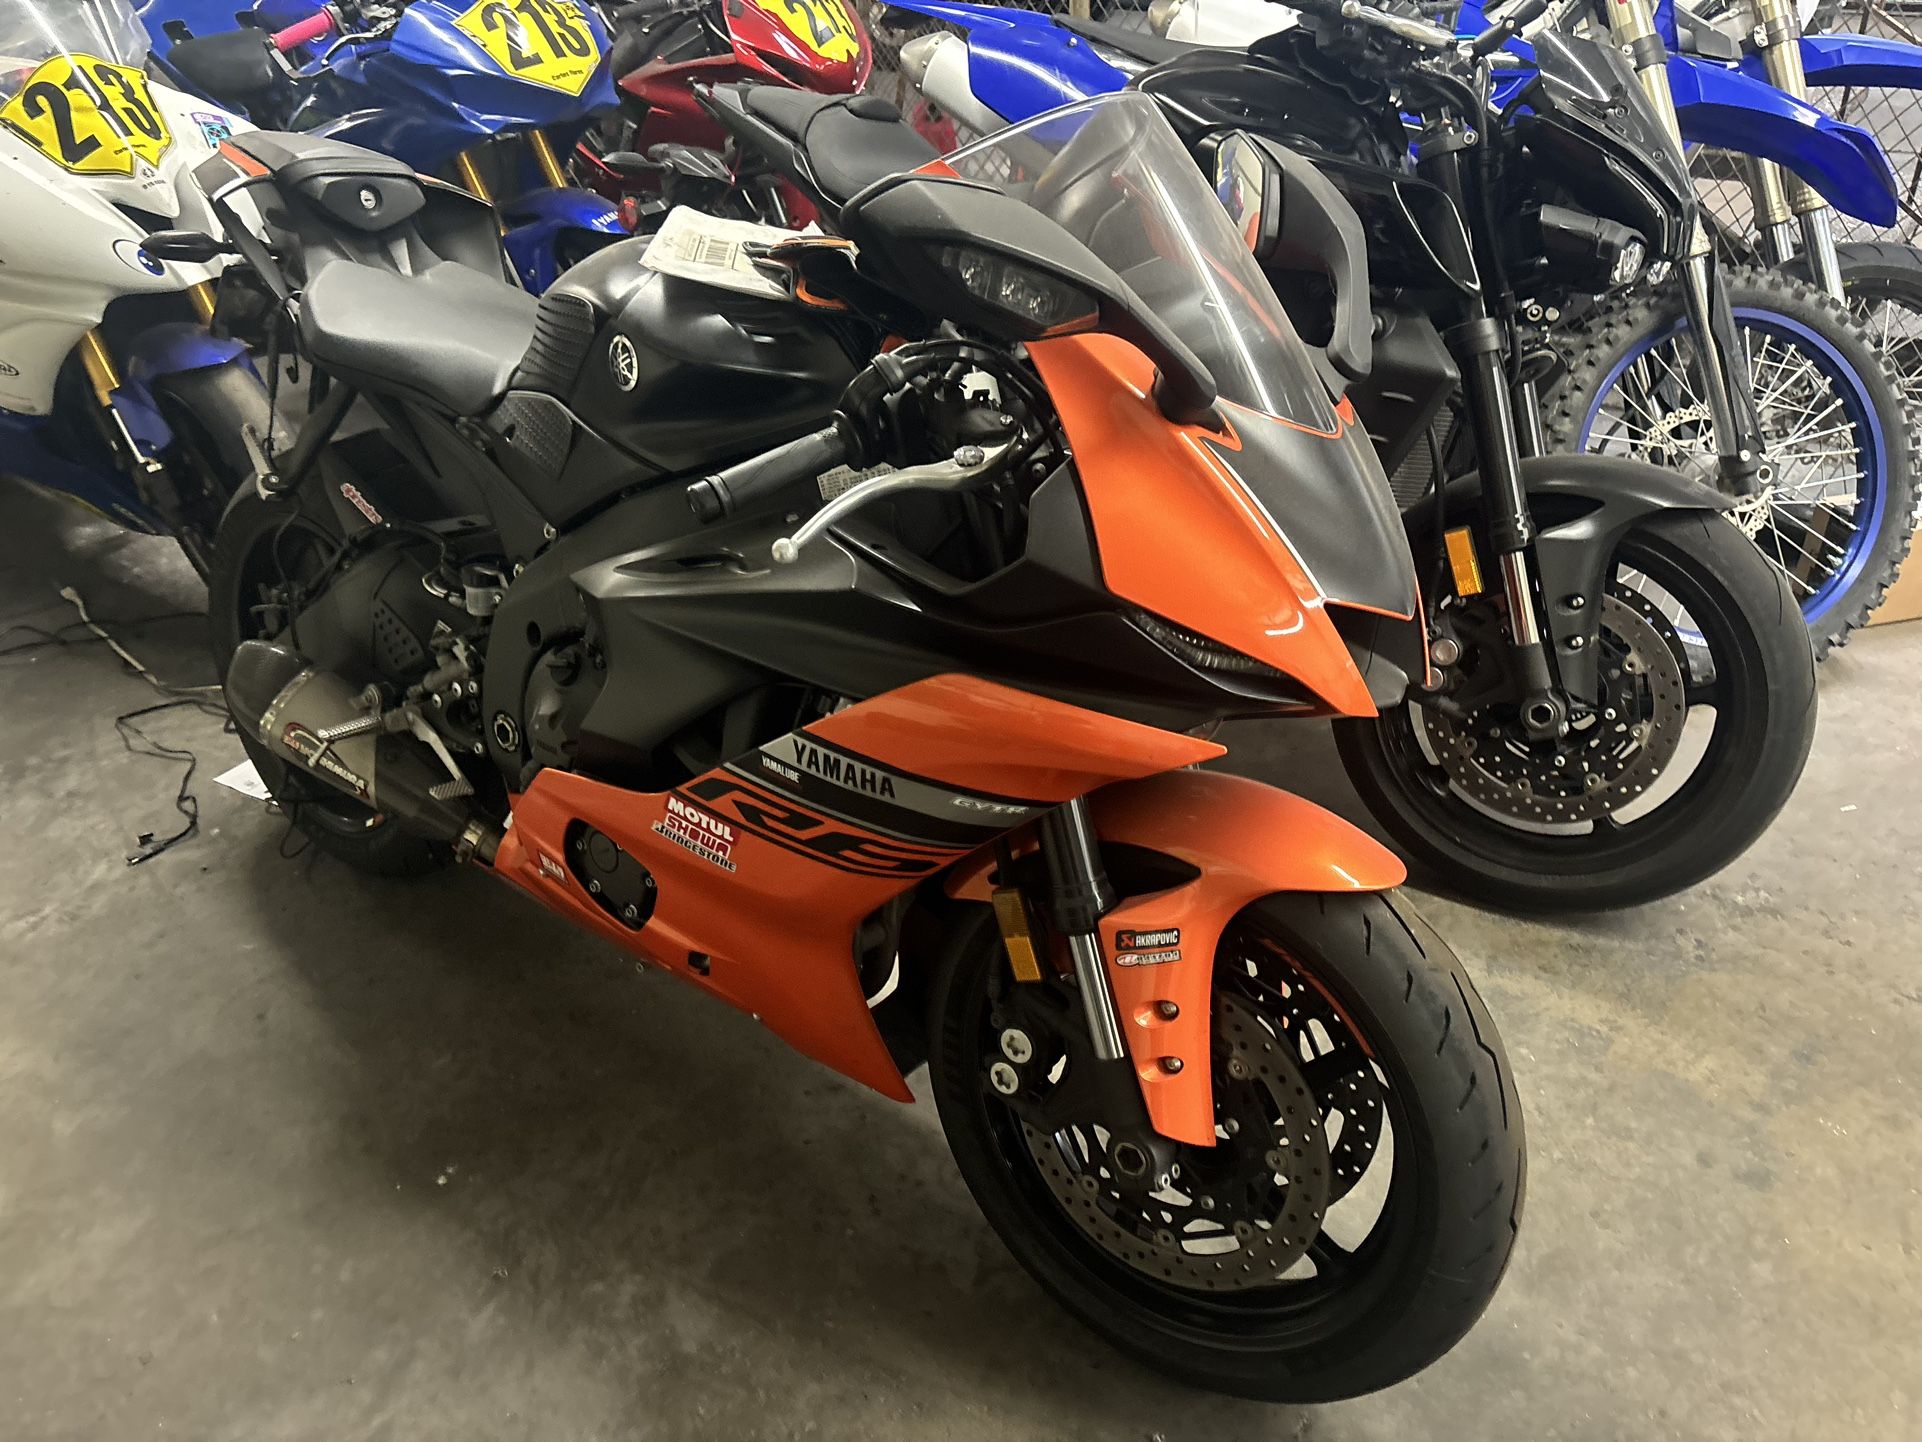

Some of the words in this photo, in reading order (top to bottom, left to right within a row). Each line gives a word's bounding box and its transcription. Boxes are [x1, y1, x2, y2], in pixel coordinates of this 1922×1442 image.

[481, 0, 591, 71] 213
[22, 64, 162, 165] 213
[761, 754, 800, 784] YAMALUBE
[792, 738, 896, 798] YAMAHA
[665, 813, 731, 859] SHOWA
[667, 796, 734, 842] MOTUL
[655, 823, 736, 872] BRIDGESTONE
